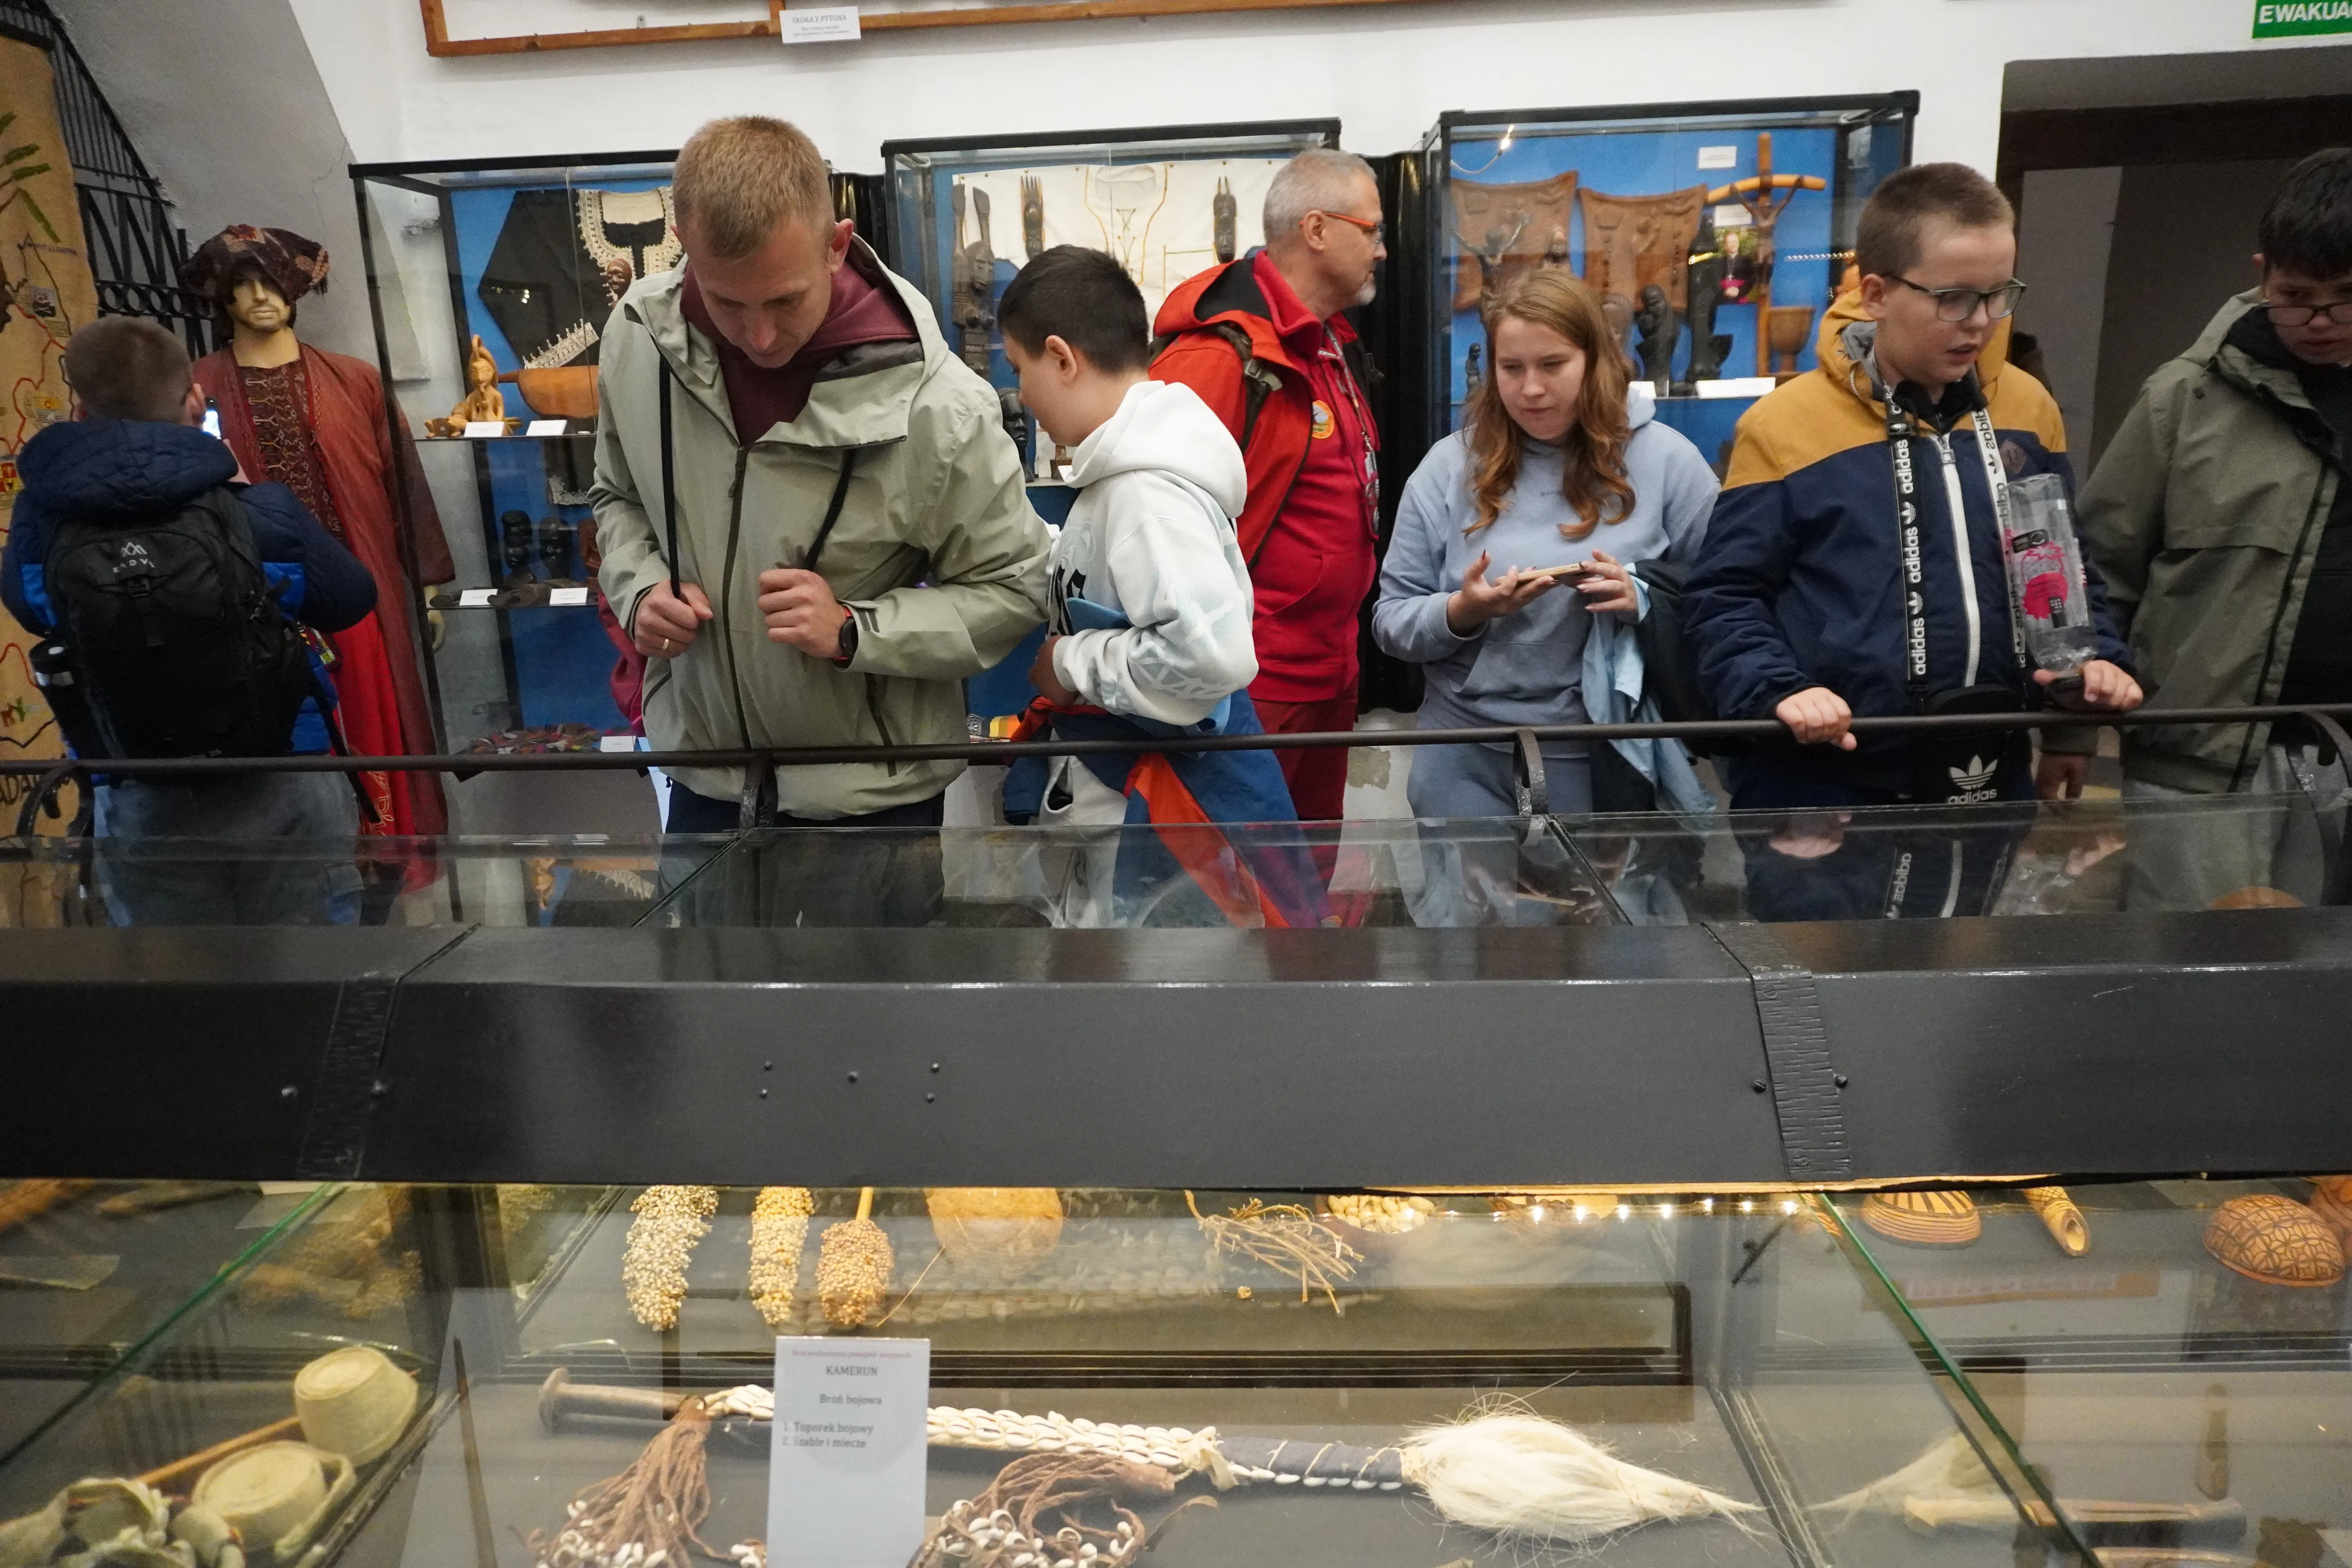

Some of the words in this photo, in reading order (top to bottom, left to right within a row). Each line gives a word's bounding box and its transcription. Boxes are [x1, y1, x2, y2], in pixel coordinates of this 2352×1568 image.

[821, 14, 847, 22] PYTONA
[2259, 1, 2352, 24] EWAKUA
[1895, 439, 1913, 494] adidas
[1905, 526, 1922, 584] adidas
[1909, 617, 1927, 675] adidas
[1947, 788, 1998, 804] adidas
[826, 1365, 878, 1376] KAMERUN
[846, 1394, 882, 1407] bojowa
[794, 1421, 835, 1434] Toporek
[838, 1421, 875, 1435] bojowy
